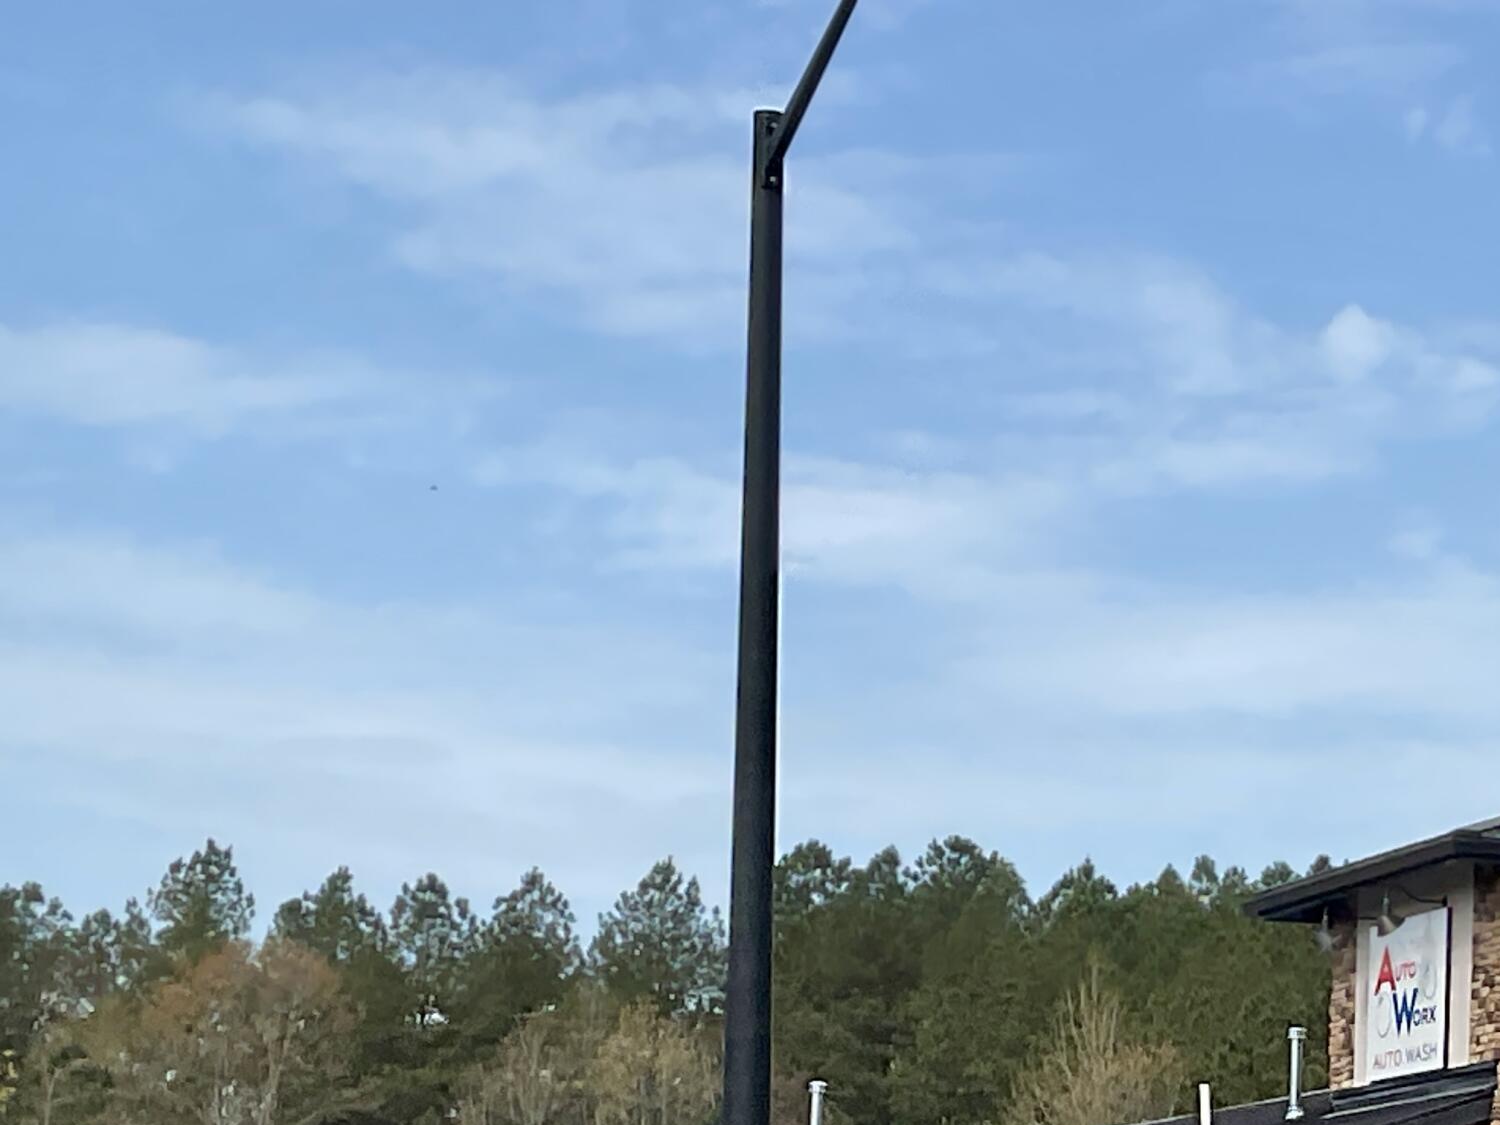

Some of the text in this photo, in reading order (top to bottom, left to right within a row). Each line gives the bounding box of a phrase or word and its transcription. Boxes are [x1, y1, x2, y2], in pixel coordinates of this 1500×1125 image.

[1374, 945, 1417, 996] AUTO
[1392, 987, 1438, 1038] WORX
[1373, 1042, 1438, 1069] AUTO WASH
